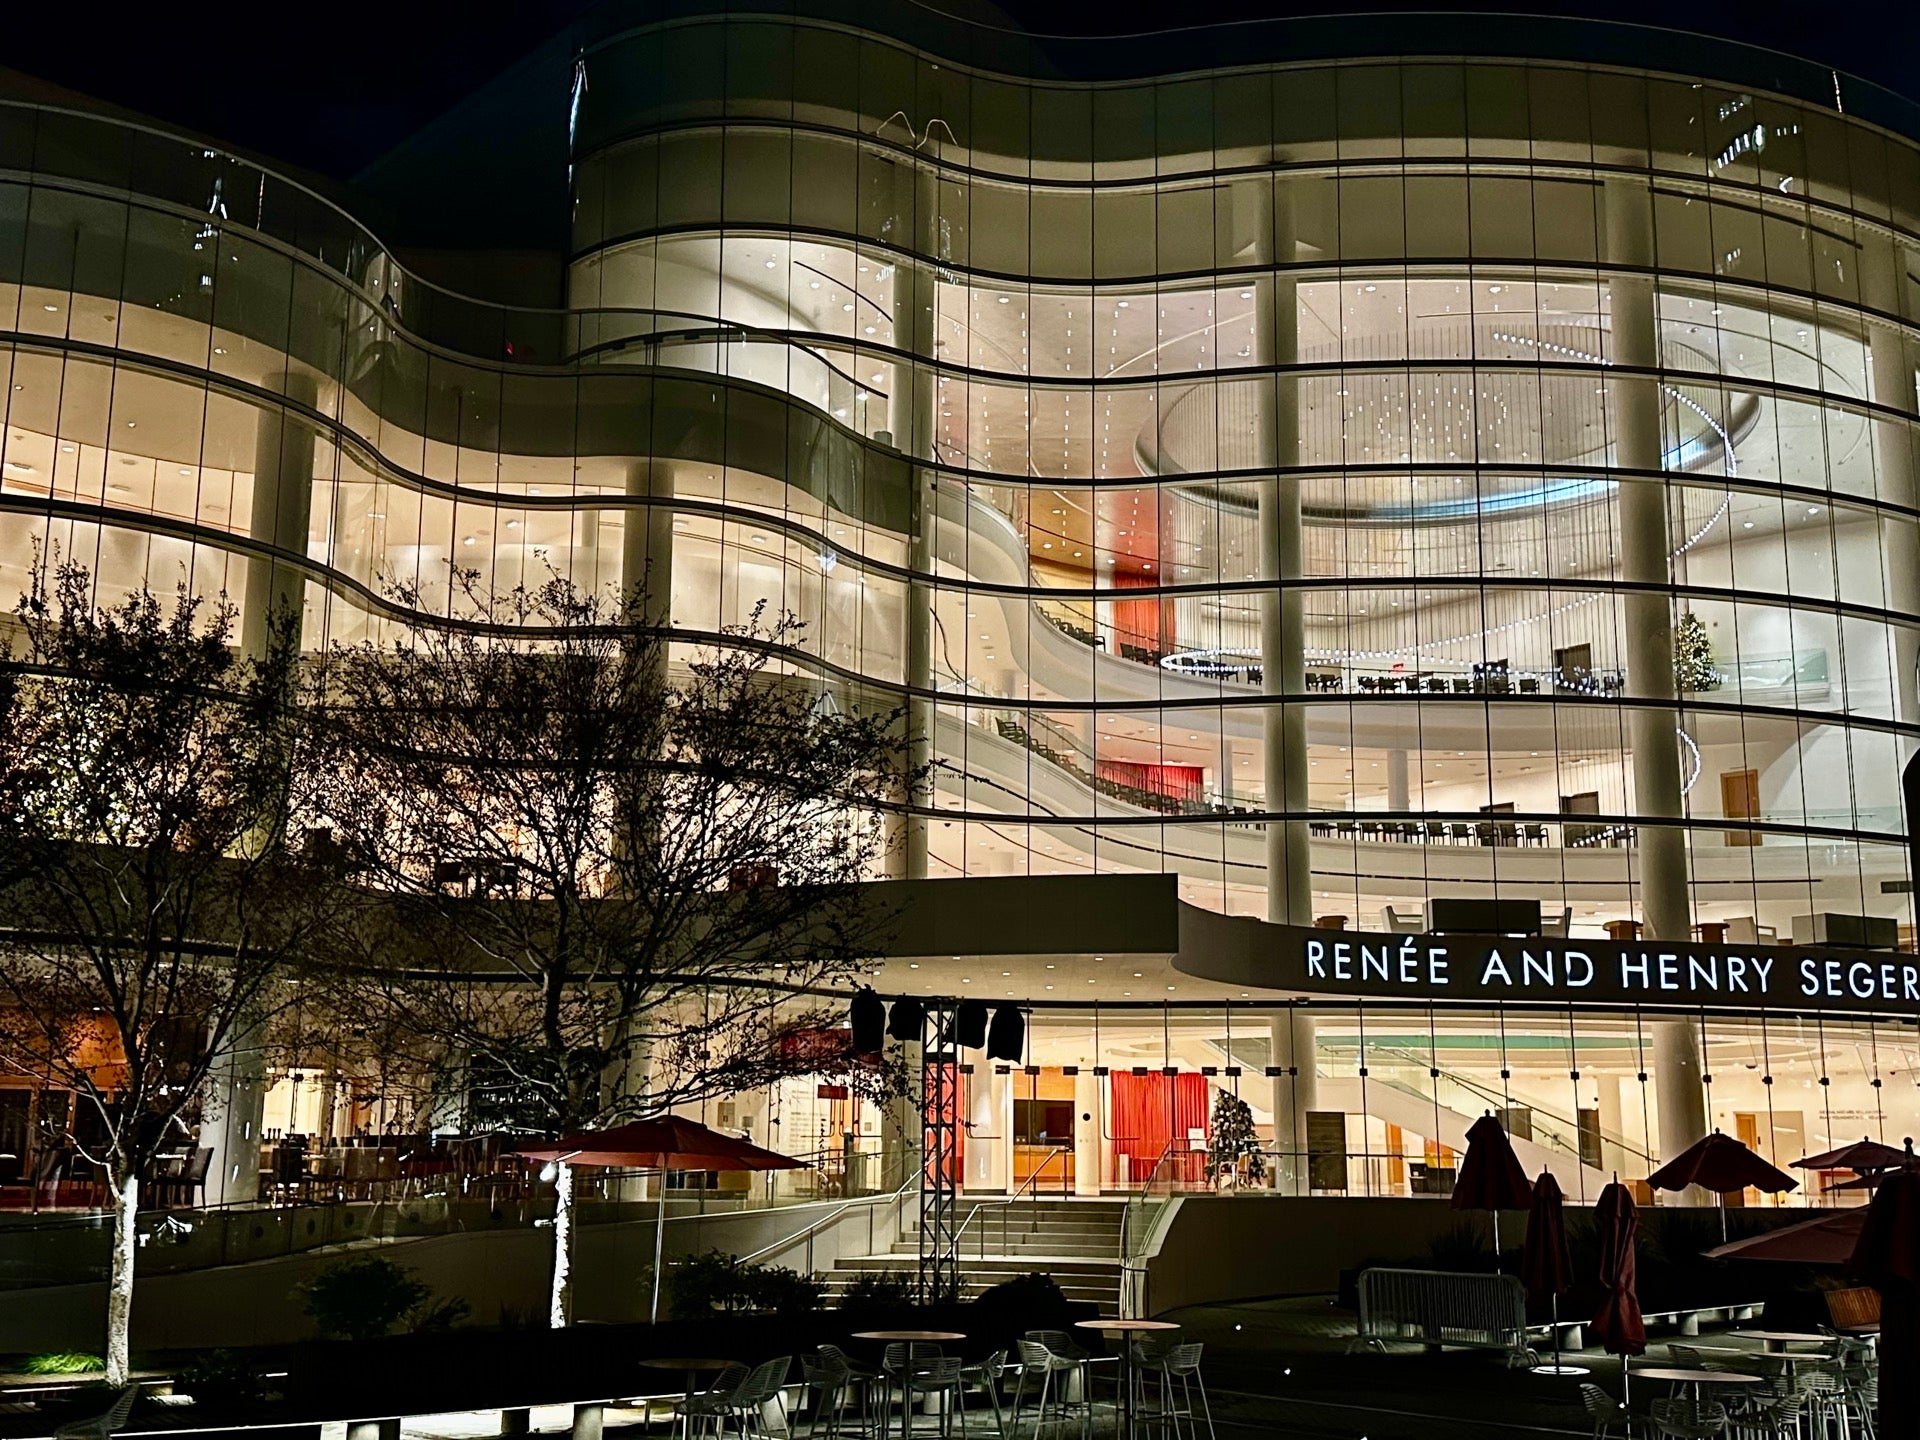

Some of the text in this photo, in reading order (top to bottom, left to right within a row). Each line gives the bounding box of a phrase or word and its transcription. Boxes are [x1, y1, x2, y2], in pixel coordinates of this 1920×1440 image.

[1307, 936, 1920, 1001] RENÉE AND HENRY SEGER
